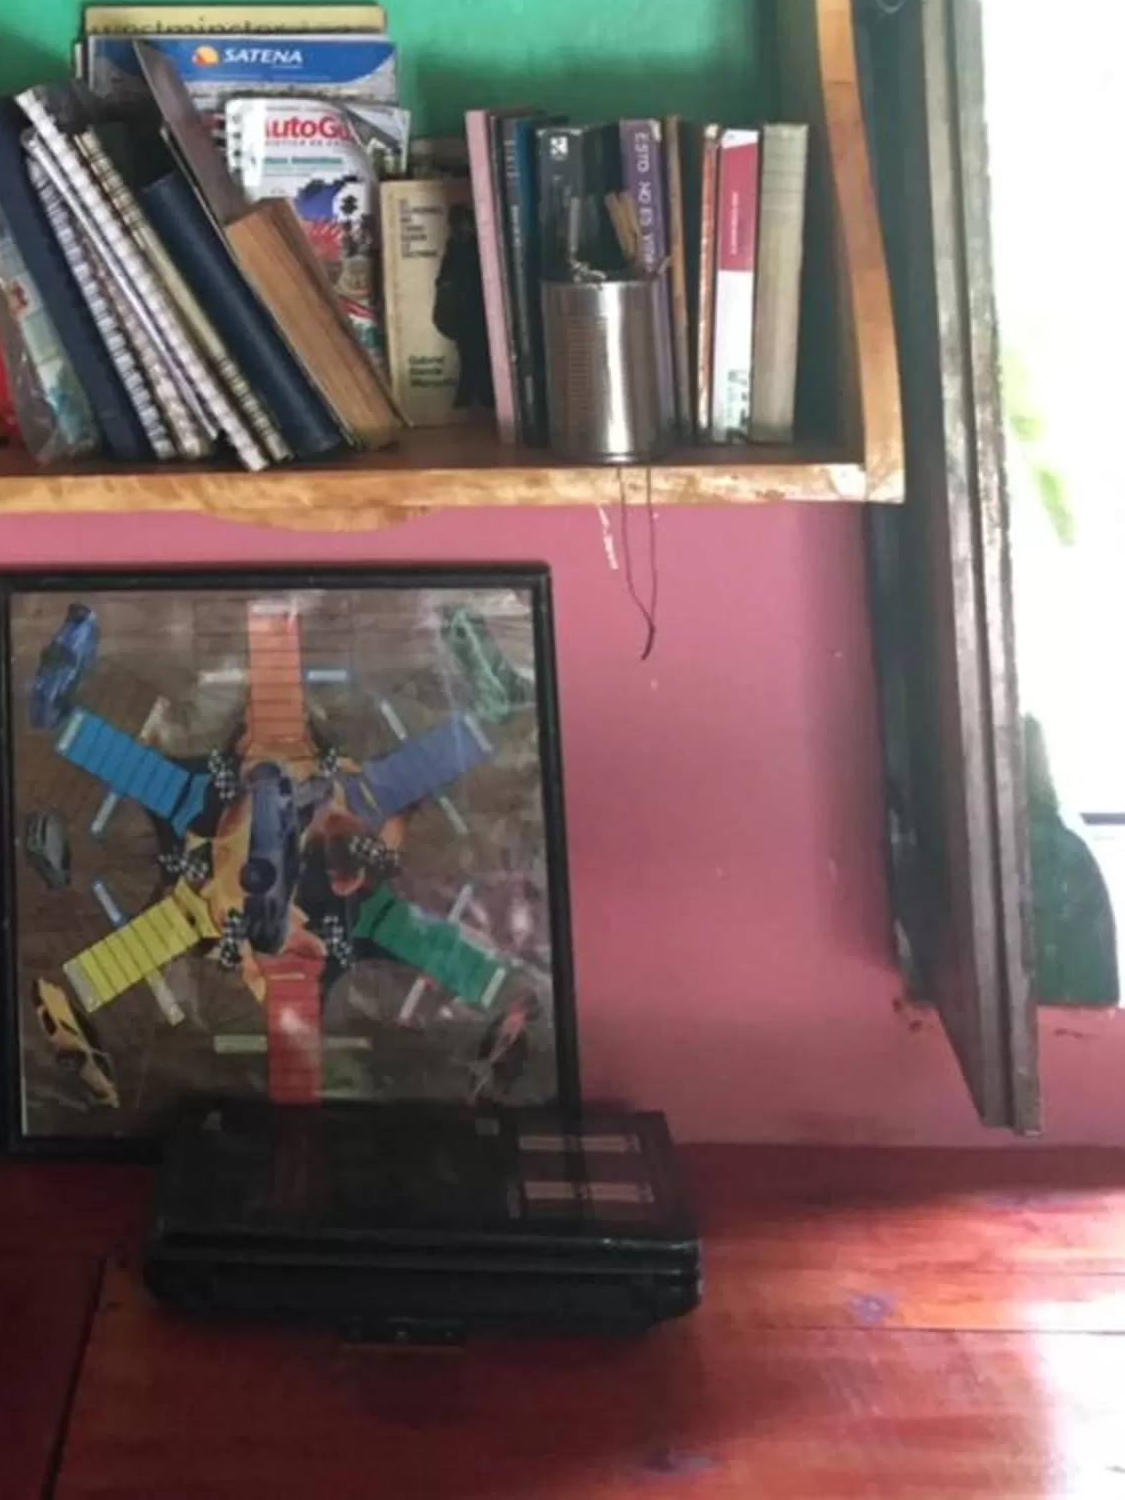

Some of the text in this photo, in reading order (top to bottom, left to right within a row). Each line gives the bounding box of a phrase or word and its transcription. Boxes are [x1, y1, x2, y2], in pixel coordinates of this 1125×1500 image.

[223, 49, 303, 64] SATENA
[634, 131, 651, 173] ESTO
[636, 180, 652, 204] NO
[638, 206, 654, 227] ES
